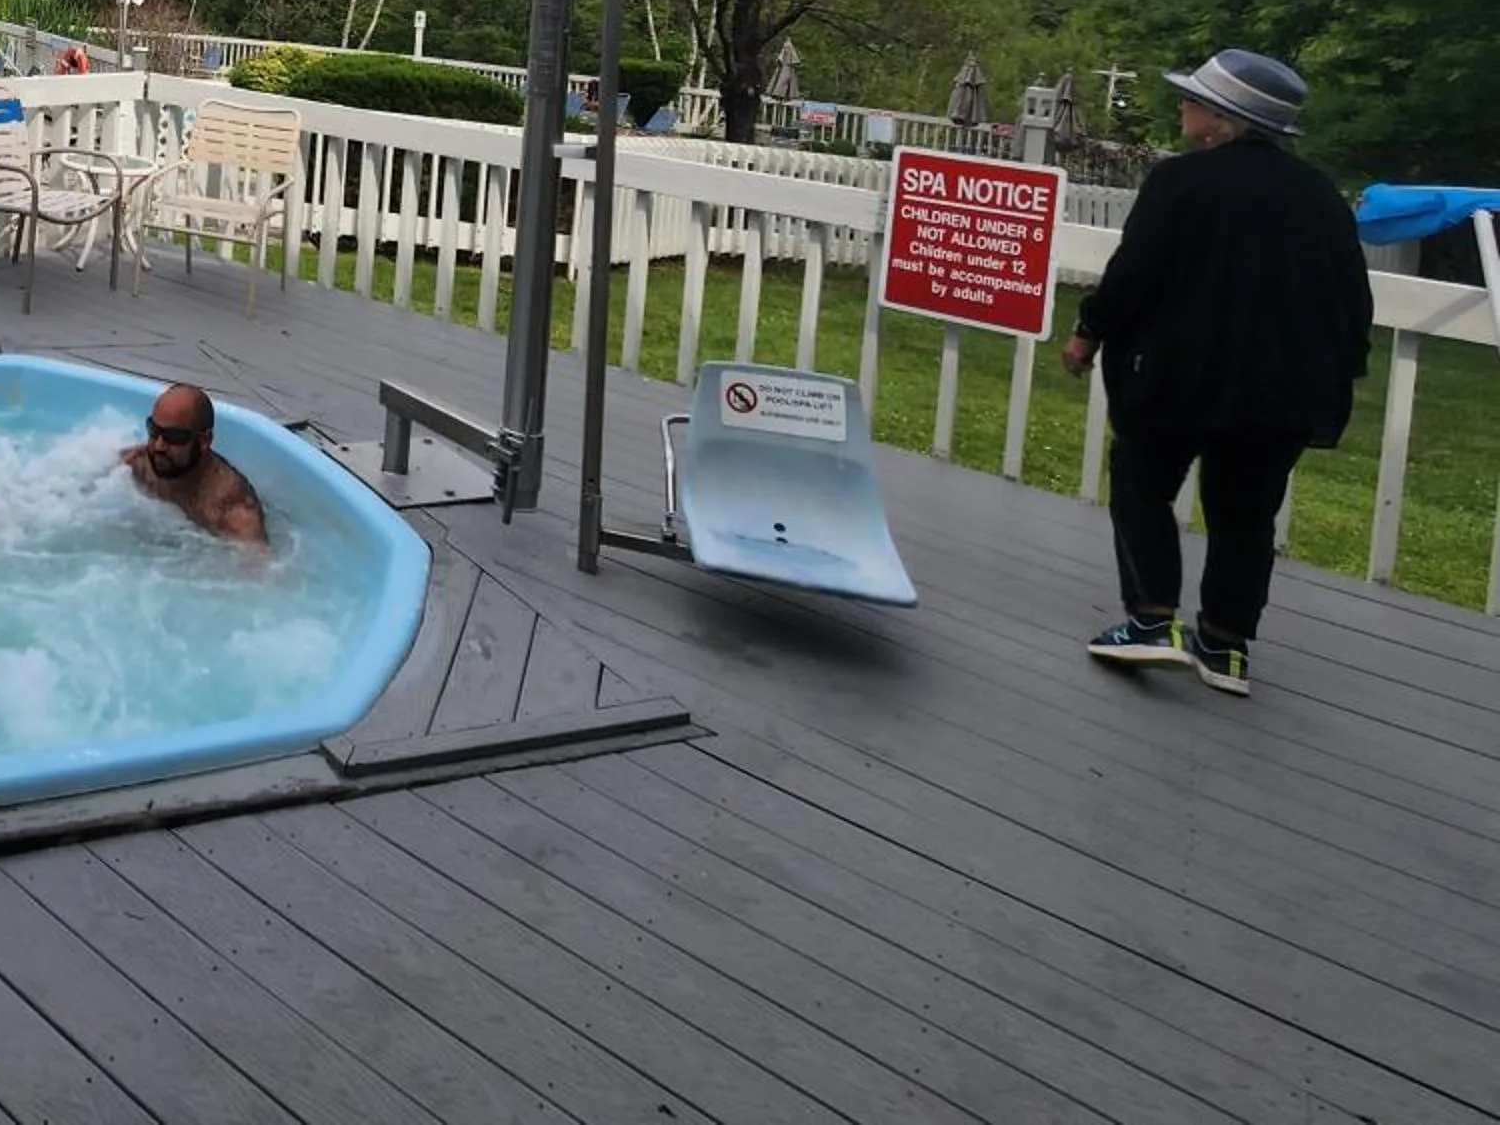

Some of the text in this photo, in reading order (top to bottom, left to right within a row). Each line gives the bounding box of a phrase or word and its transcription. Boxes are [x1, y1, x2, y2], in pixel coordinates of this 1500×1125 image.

[902, 168, 1050, 212] SPA NOTICE
[901, 205, 1044, 242] CHILDREN UNDER 6
[917, 225, 1022, 256] NOT ALLOWED
[909, 241, 1026, 275] Children under 12
[892, 258, 1042, 296] must be accompanied
[931, 281, 994, 305] by adults
